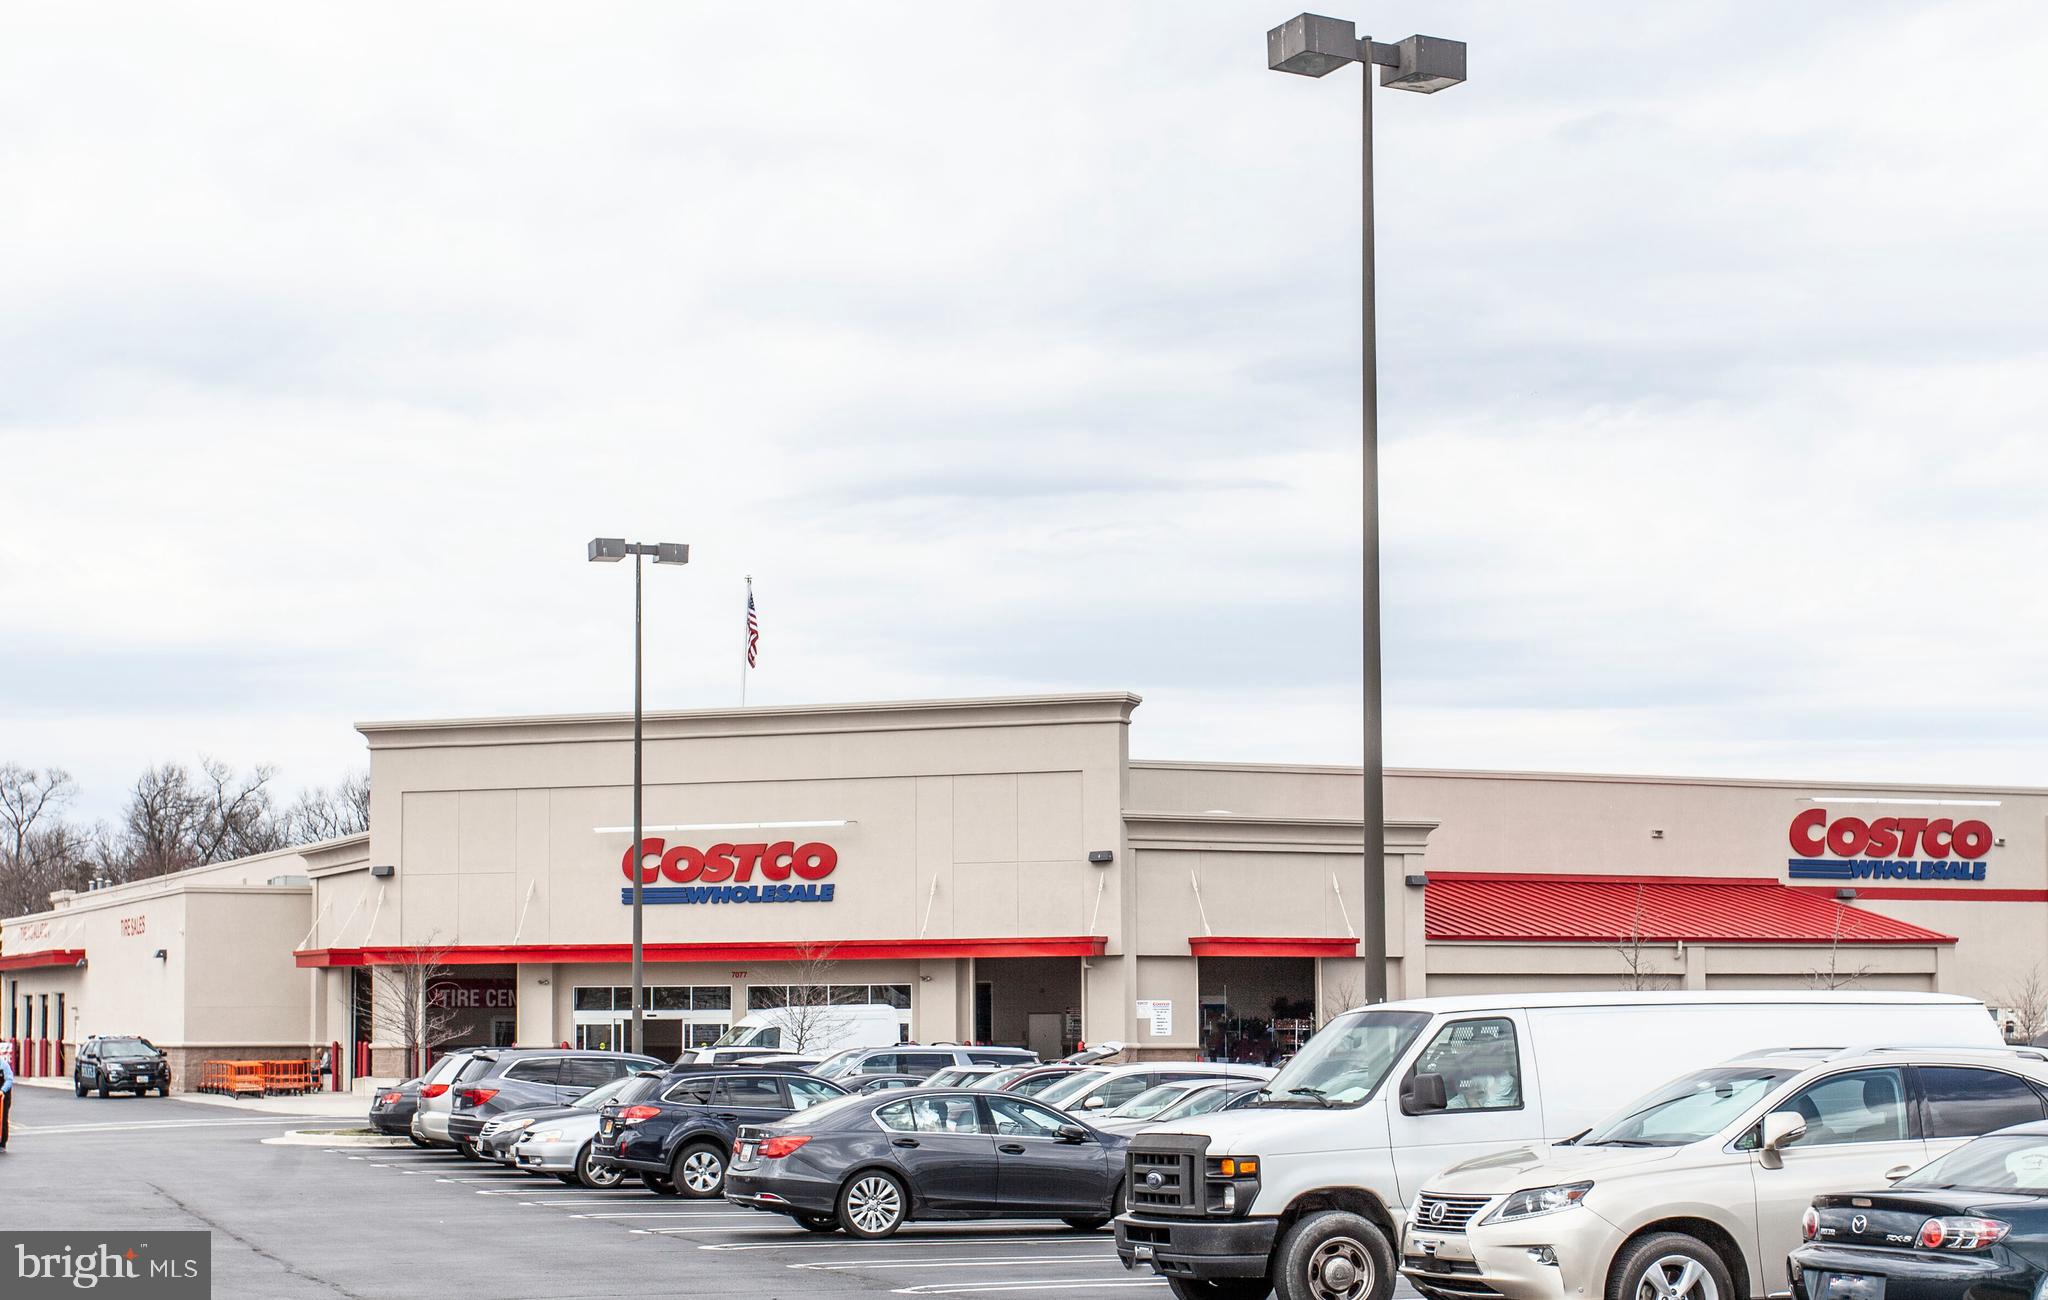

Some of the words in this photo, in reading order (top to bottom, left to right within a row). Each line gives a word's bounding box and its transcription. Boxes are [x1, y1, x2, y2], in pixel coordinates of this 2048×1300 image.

[1789, 808, 1993, 859] COSTCO
[622, 837, 838, 884] COSTCO
[1850, 860, 1987, 881] WHOLESALE
[686, 884, 836, 904] WHOLESALE
[131, 914, 146, 935] SALES
[442, 989, 480, 1007] TIRE
[1886, 1234, 1913, 1243] RX-8
